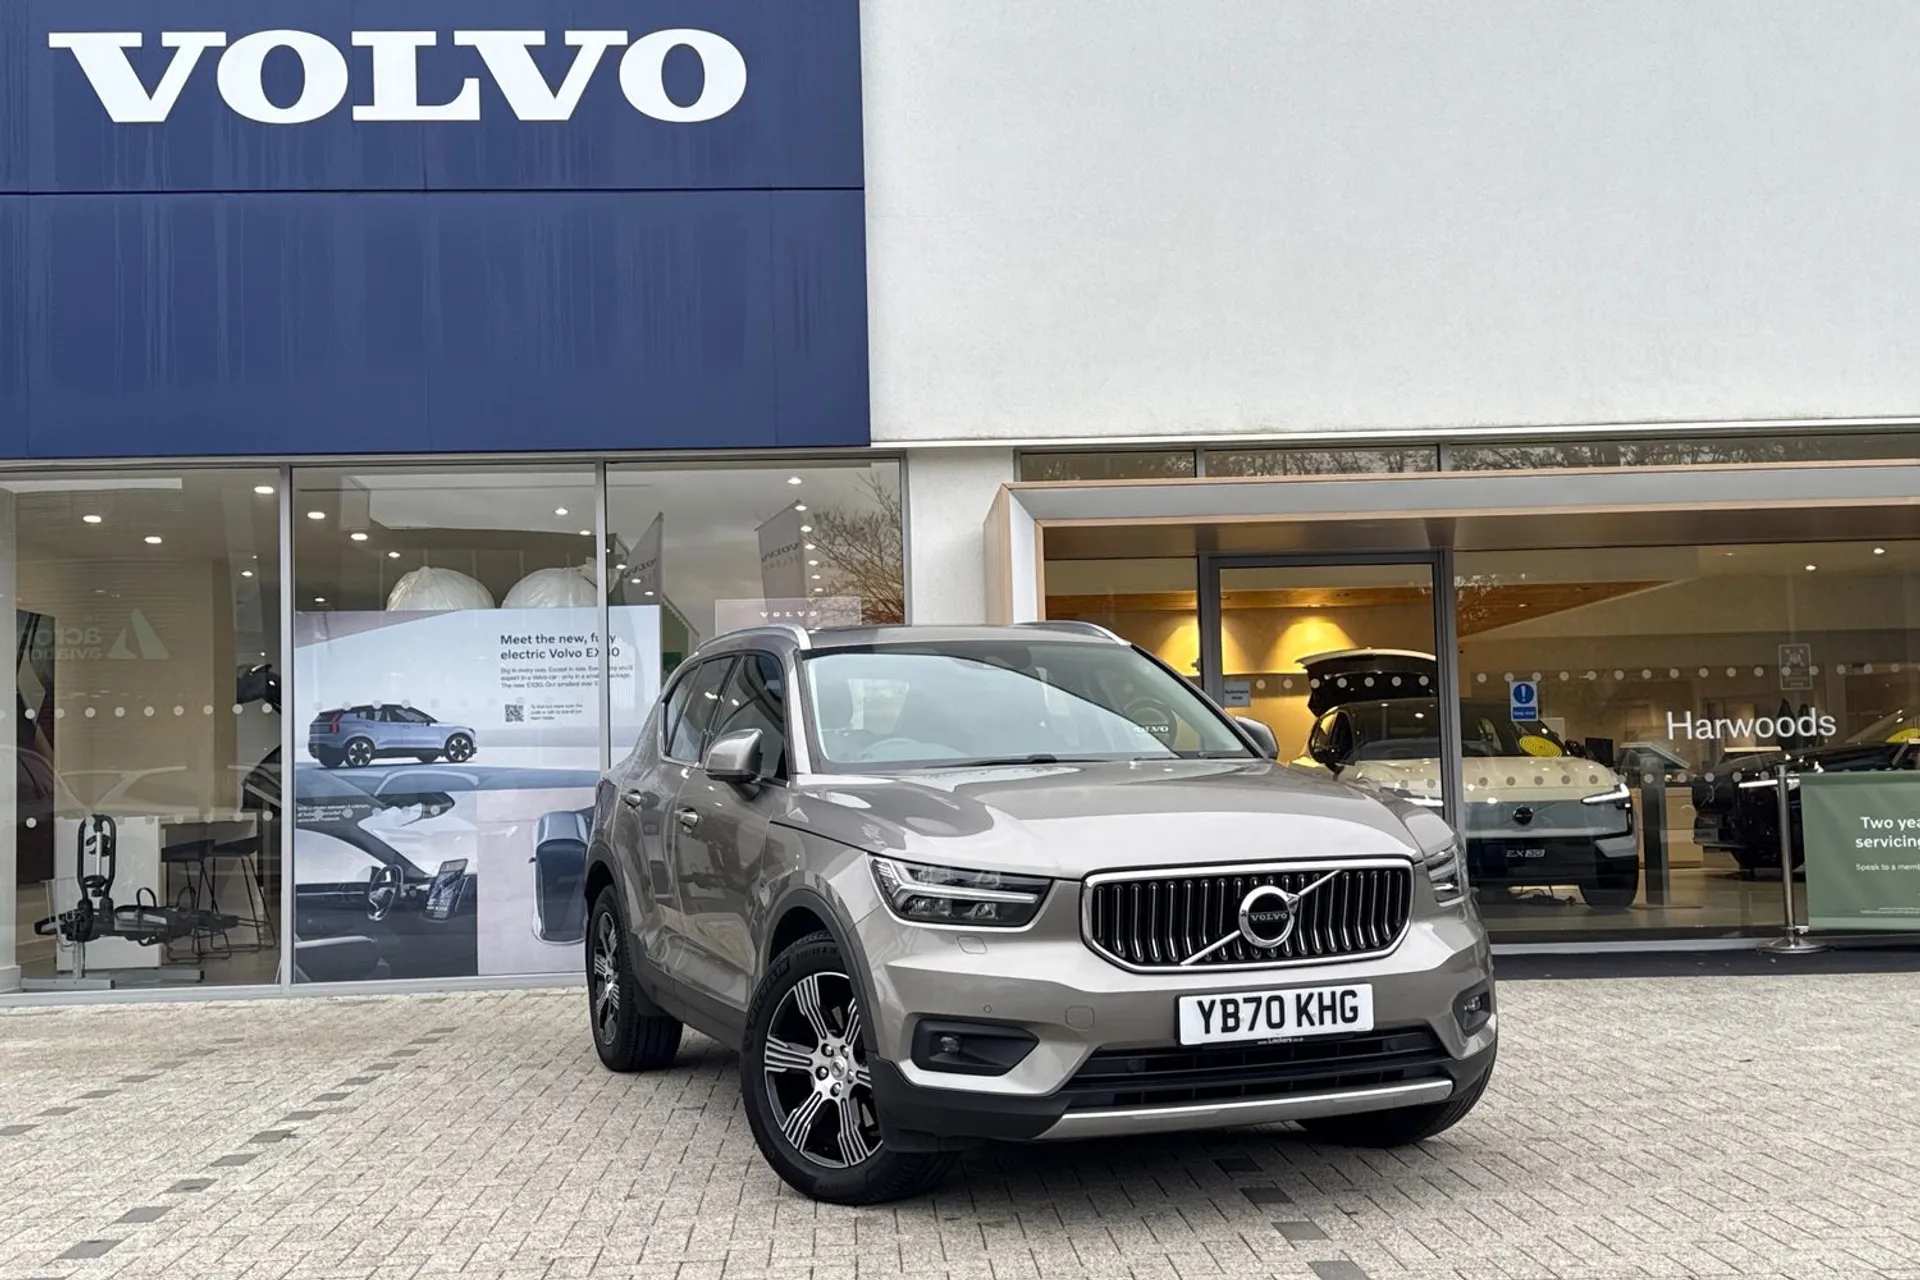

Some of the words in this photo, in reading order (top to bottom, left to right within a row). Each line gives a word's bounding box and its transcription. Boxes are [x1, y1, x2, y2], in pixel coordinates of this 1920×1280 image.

[48, 28, 748, 125] VOLVO
[760, 610, 817, 618] VOLVO
[500, 635, 532, 645] Meet
[535, 634, 556, 644] the
[558, 635, 588, 645] new,
[591, 632, 616, 644] fuy
[500, 649, 546, 660] electric
[549, 647, 582, 659] Volvo
[586, 647, 620, 658] EX0
[1666, 707, 1837, 740] Harwoods
[1860, 816, 1894, 829] Two
[1855, 863, 1880, 871] Speak
[1250, 912, 1288, 922] VOLVO
[1196, 994, 1286, 1035] YB70
[1295, 989, 1358, 1028] KHG
